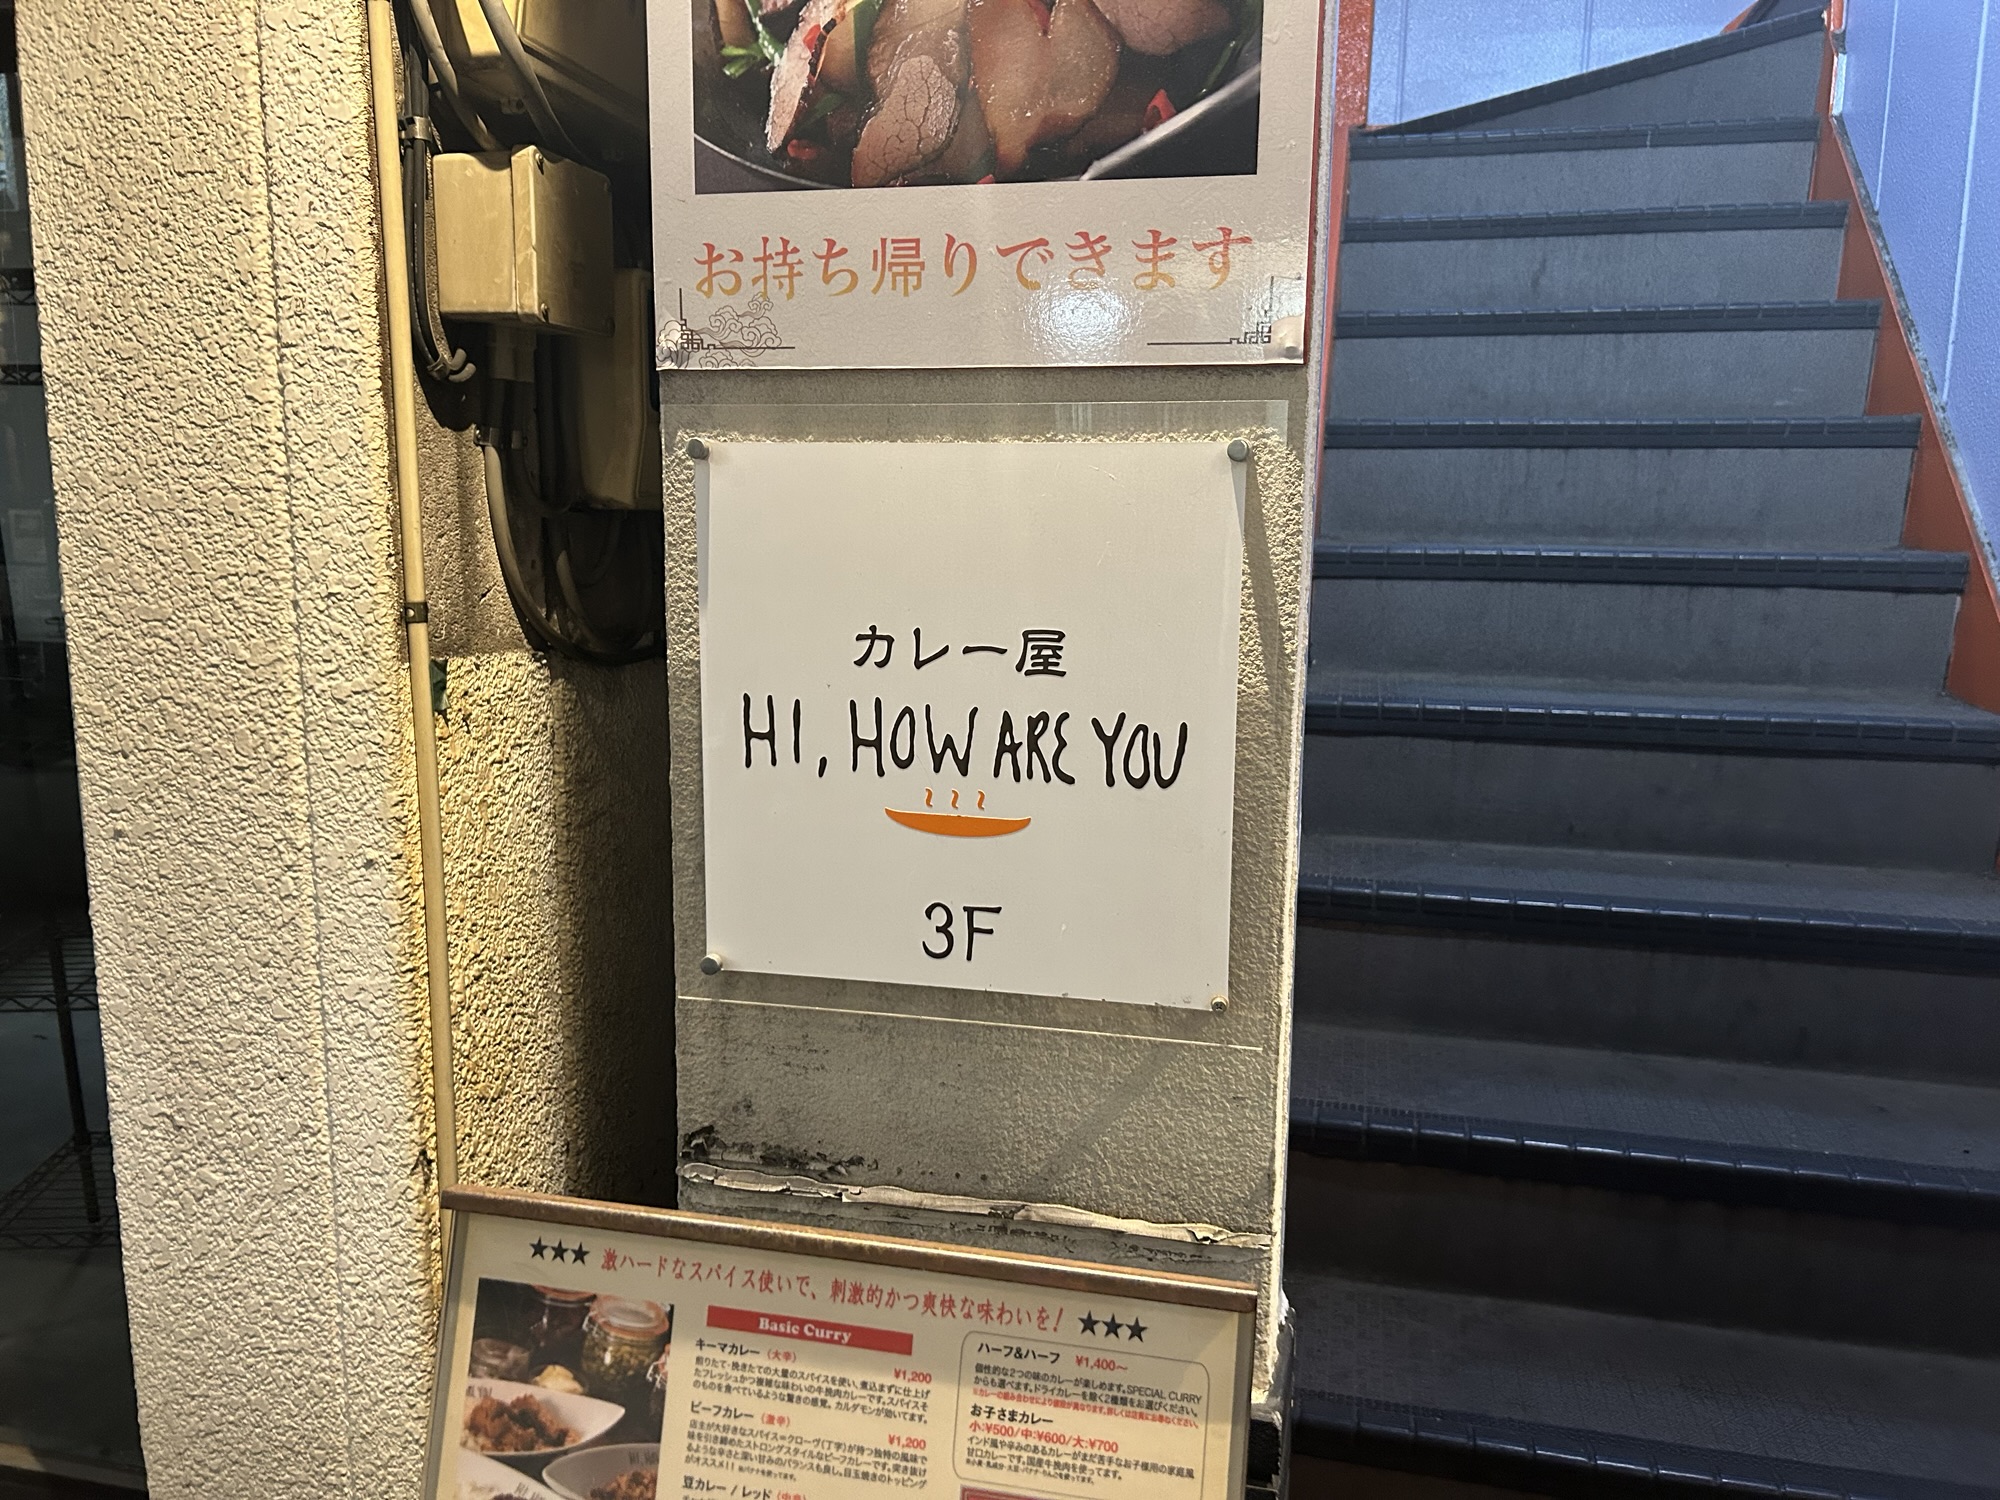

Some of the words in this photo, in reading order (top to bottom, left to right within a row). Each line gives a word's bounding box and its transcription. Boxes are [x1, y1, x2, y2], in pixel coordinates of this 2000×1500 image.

[693, 225, 1253, 301] お持ち帰りできます
[853, 624, 1067, 677] カレー屋
[743, 693, 827, 778] HI,
[849, 696, 979, 778] HOW
[993, 710, 1076, 785] ARE
[1091, 712, 1188, 789] YOU
[921, 902, 1002, 961] 3F
[758, 1316, 799, 1337] Basic
[802, 1321, 852, 1344] Curry
[695, 1338, 760, 1356] キーマカレー
[977, 1343, 1061, 1364] ハーフ&ハーフ
[894, 1368, 932, 1383] ¥1,200
[1168, 1388, 1202, 1405] CURRY
[690, 1400, 754, 1419] ビーフカレー
[970, 1403, 1053, 1425] お子さまカレー
[888, 1434, 927, 1449] ¥1,200
[682, 1475, 726, 1491] 豆カレー
